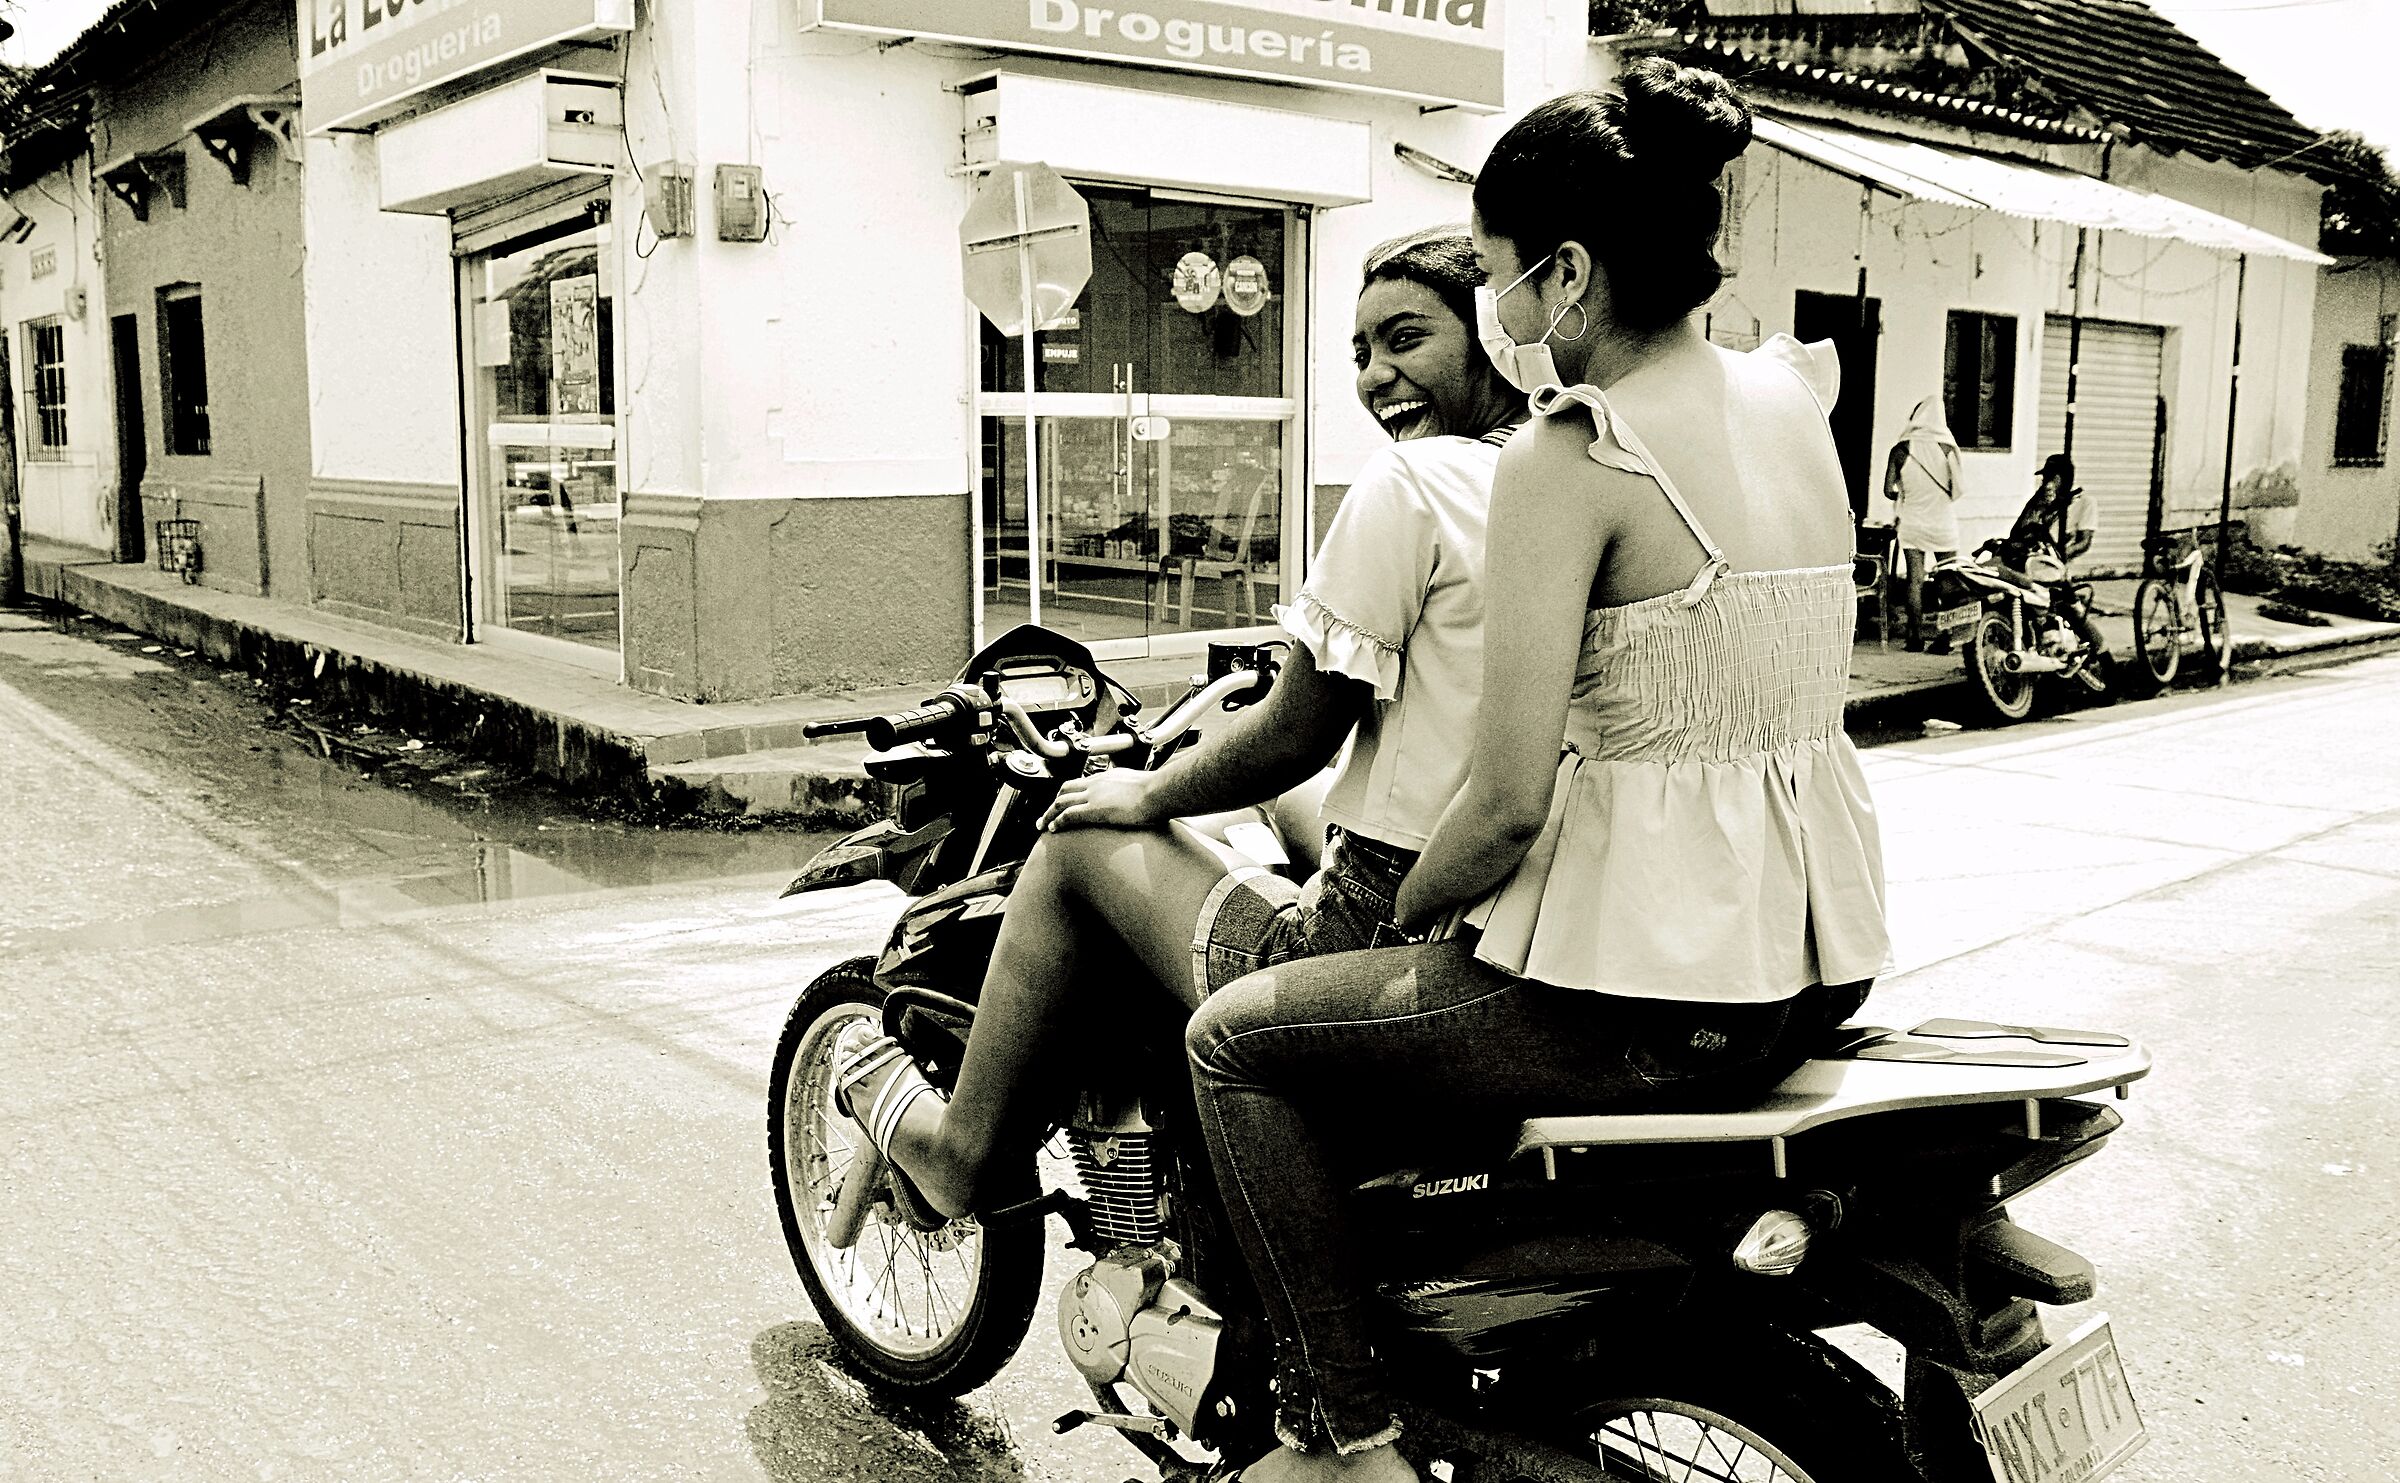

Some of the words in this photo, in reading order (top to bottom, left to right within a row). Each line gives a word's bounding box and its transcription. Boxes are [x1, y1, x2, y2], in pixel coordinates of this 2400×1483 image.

[310, 0, 346, 57] La
[1029, 0, 1372, 72] Droguería
[1412, 1173, 1489, 1199] SUZUKI
[1147, 1364, 1193, 1398] SUZUKI
